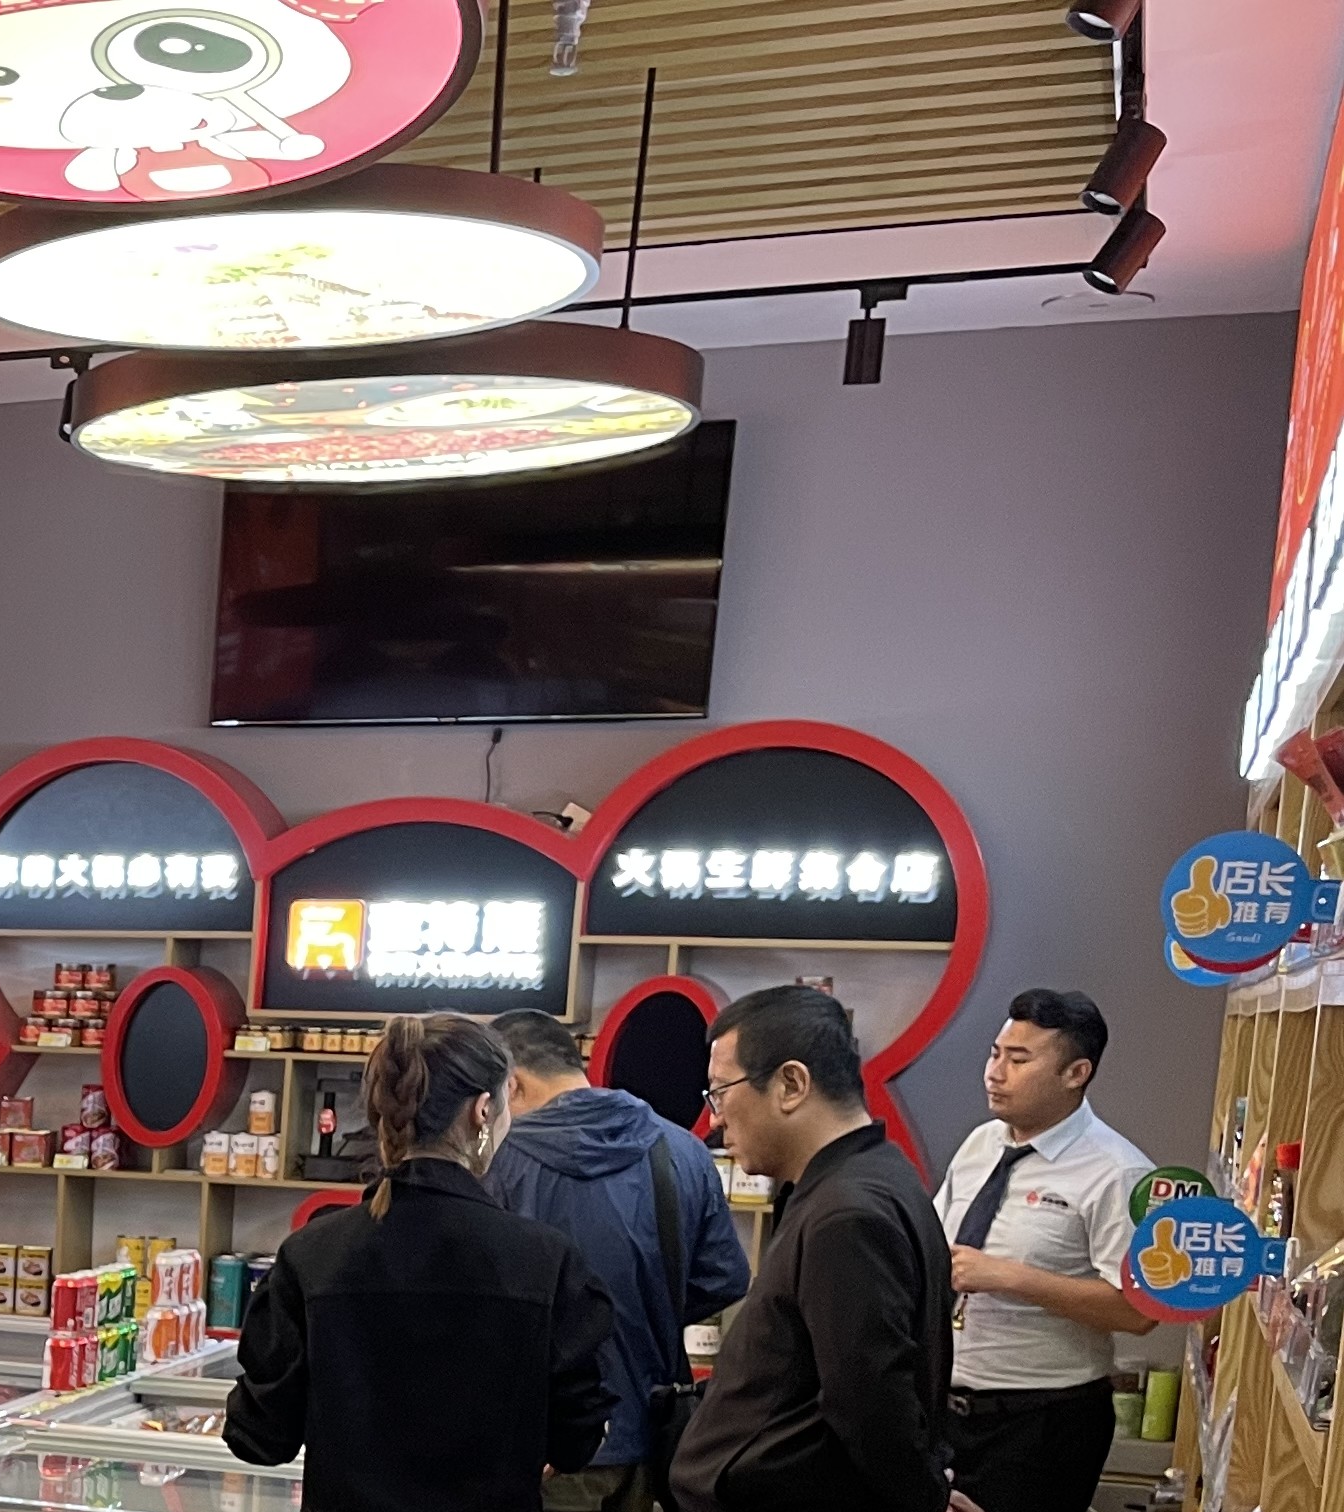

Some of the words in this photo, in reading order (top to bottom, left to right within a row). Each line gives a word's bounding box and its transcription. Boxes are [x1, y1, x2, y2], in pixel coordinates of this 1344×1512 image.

[1220, 860, 1294, 895] 店长
[1232, 900, 1290, 925] 推荐
[1150, 1178, 1202, 1200] DM
[1179, 1222, 1246, 1253] 店长
